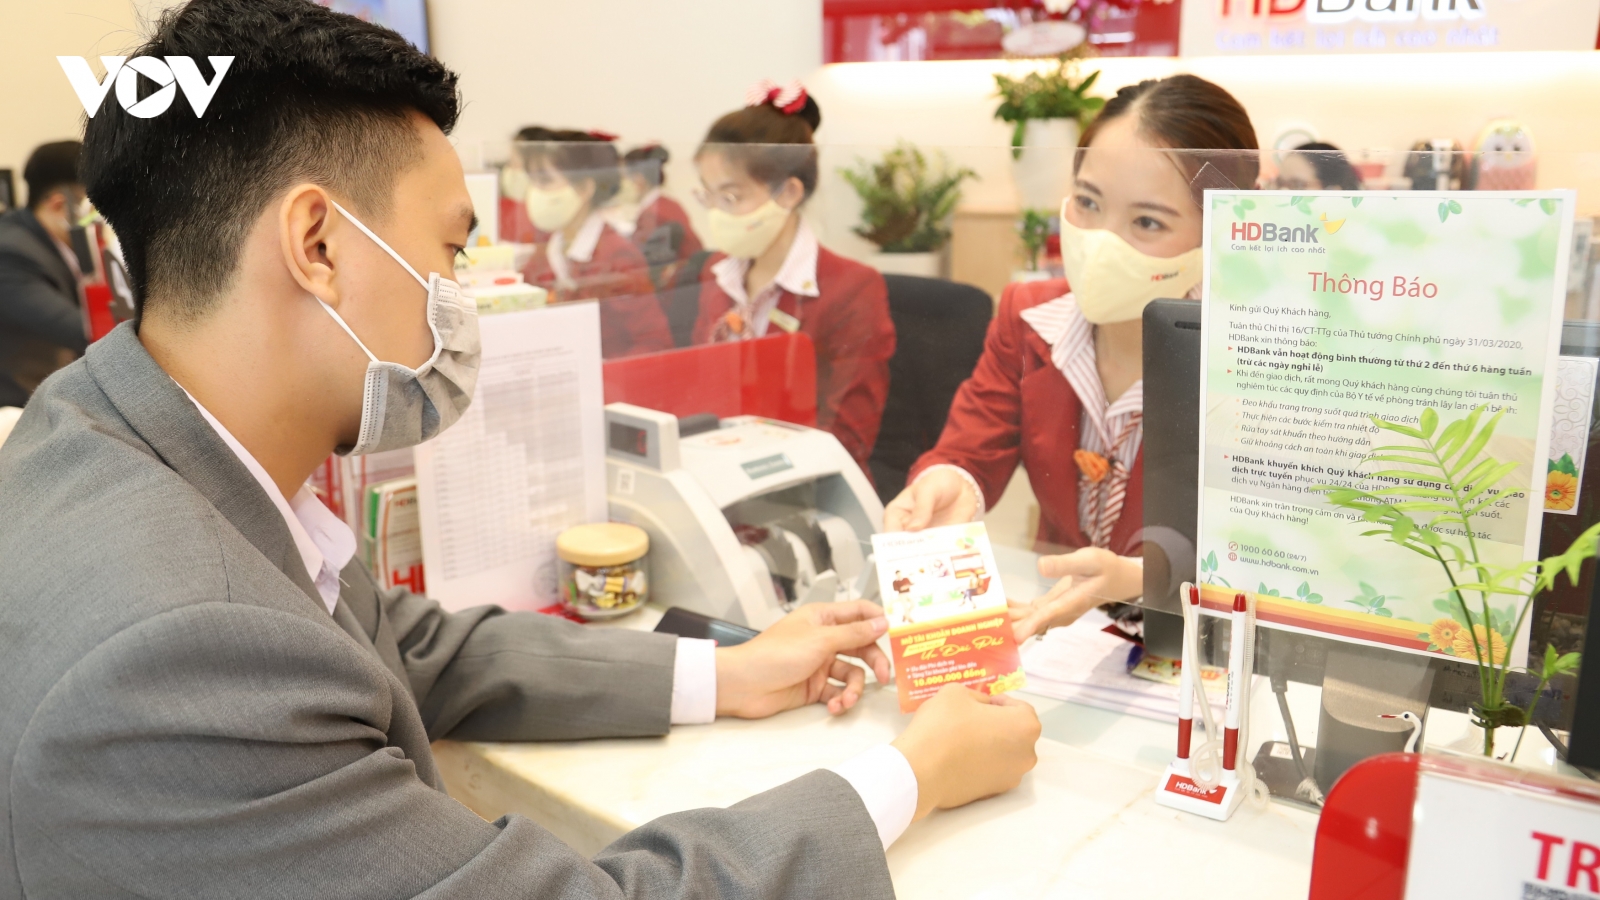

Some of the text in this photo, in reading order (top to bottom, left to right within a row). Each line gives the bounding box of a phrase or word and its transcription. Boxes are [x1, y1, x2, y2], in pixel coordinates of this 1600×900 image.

[1231, 222, 1319, 243] HDBank
[1231, 243, 1246, 251] Cam
[1308, 272, 1438, 301] Thông Báo
[1229, 304, 1331, 319] Kính gửi Quý Khách hàng,
[1228, 333, 1318, 347] HDBank xin thông báo:
[1229, 321, 1524, 350] Tuân thủ Chỉ thị 16/CT-TTg của Thủ tướng Chính phủ ngày 31/03/2020,
[1237, 345, 1532, 377] HDBank vẫn hoạt động bình thường từ thứ 2 đến thứ 6 hàng tuần
[1237, 357, 1253, 366] (trừ
[1253, 358, 1267, 367] các
[1268, 361, 1290, 370] ngày
[1291, 362, 1311, 372] nghỉ
[1236, 369, 1518, 402] Khi đến giao dịch, rất mong Quý khách hàng cùng chúng tôi tuân thủ
[1236, 382, 1265, 392] nghiêm
[1266, 382, 1278, 392] túc
[1280, 385, 1293, 393] các
[1294, 387, 1309, 396] quy
[1310, 388, 1328, 398] định
[1330, 390, 1344, 399] của
[1346, 391, 1357, 401] Bộ
[1358, 392, 1364, 400] Y
[1365, 392, 1374, 401] tế
[1375, 393, 1385, 402] về
[1386, 395, 1414, 407] phòng
[1415, 398, 1439, 408] tránh
[1440, 399, 1453, 410] lây
[1454, 401, 1468, 410] lan
[1242, 398, 1419, 425] Đeo khẩu trang trong suốt quá dịch
[1261, 413, 1368, 433] hiện các bước kiểm tra nhiệt
[1257, 426, 1353, 446] tay sát khuẩn theo hướng
[1284, 442, 1302, 451] cách
[1315, 446, 1333, 456] toàn
[1335, 448, 1347, 457] khi
[1349, 451, 1367, 460] giao
[1232, 455, 1265, 465] HDBank
[1267, 458, 1298, 470] khuyến
[1301, 463, 1324, 474] khích
[1327, 467, 1345, 477] Quý
[1231, 476, 1301, 493] dịch vụ Ngân hàng
[1231, 465, 1249, 475] dịch
[1250, 468, 1267, 478] trực
[1269, 471, 1293, 482] tuyến
[1294, 474, 1315, 484] phục
[1329, 479, 1352, 488] 24/24
[1494, 500, 1510, 509] các
[1229, 506, 1309, 526] của Quý Khách hàng!
[1230, 495, 1260, 506] HDBank
[1261, 500, 1273, 508] xin
[1274, 502, 1291, 511] trân
[1292, 504, 1313, 516] trọng
[1346, 512, 1356, 521] và
[1477, 531, 1492, 540] tác
[1240, 544, 1307, 562] 1900 60 60 (24/7)
[1240, 556, 1319, 576] www.hdbank.com.vn
[913, 671, 962, 687] 10.000.000
